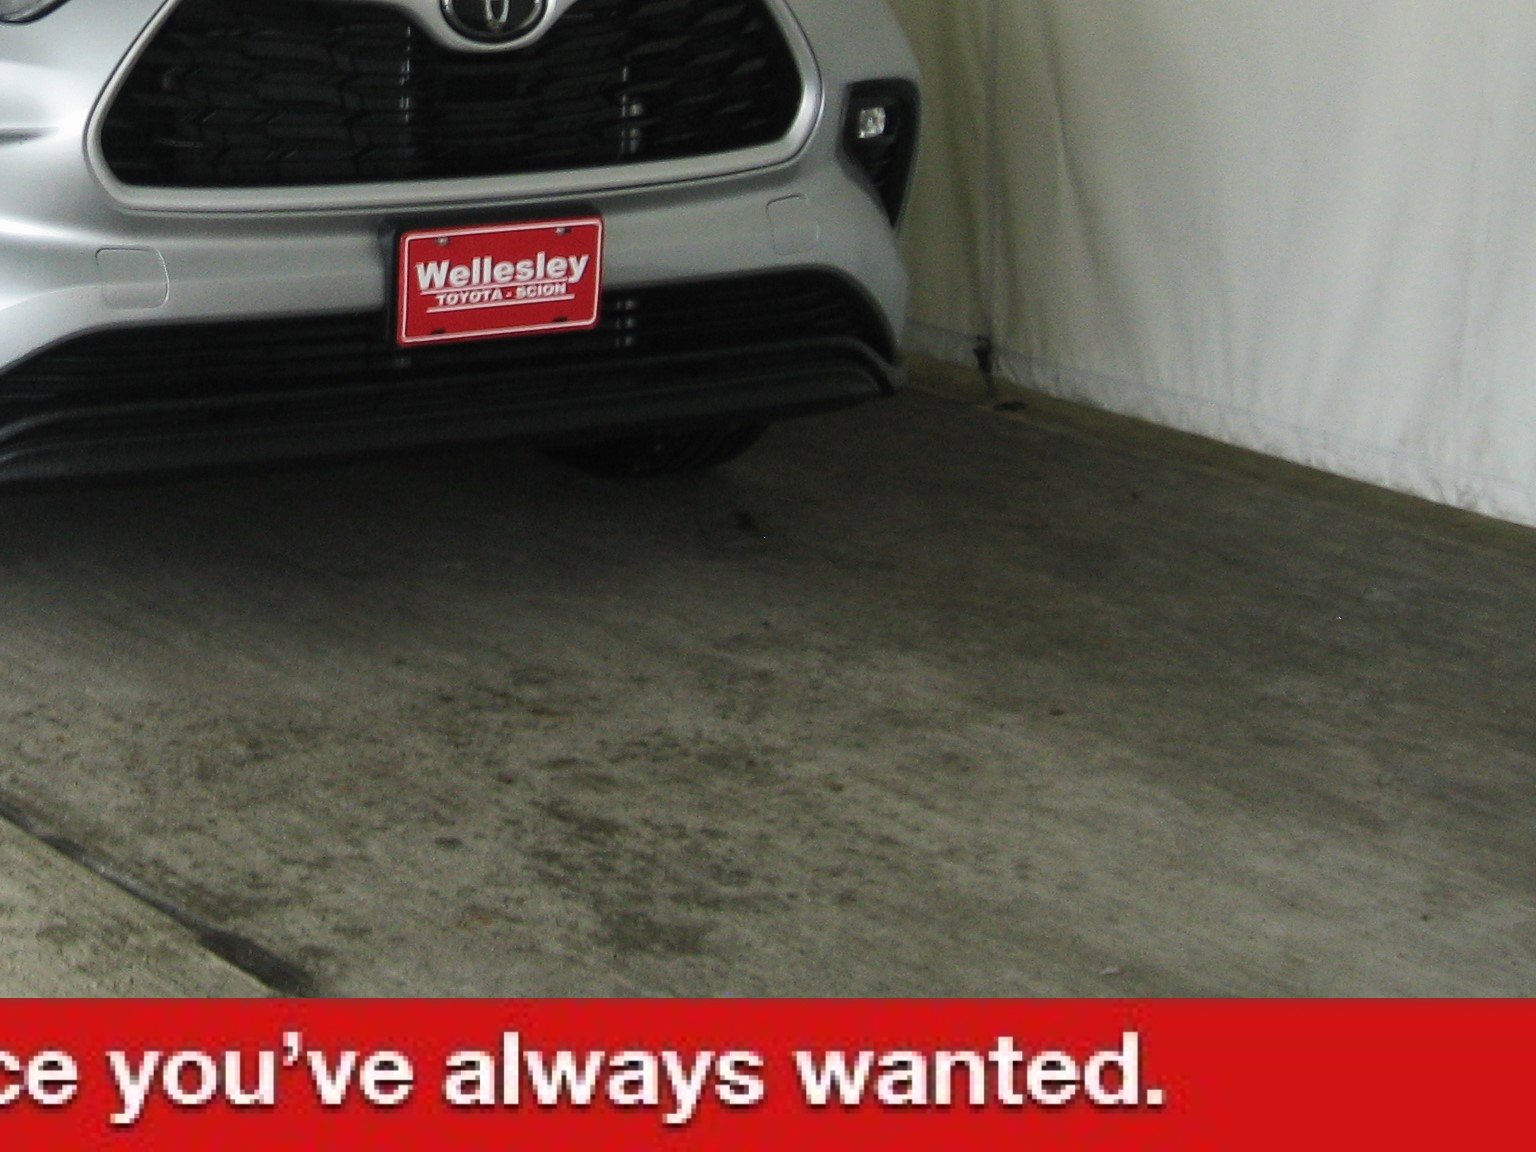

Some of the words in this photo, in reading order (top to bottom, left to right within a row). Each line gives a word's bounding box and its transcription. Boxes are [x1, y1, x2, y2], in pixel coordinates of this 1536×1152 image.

[416, 251, 589, 290] Wellesley
[436, 288, 503, 306] TOYOTA
[516, 282, 566, 298] SCION
